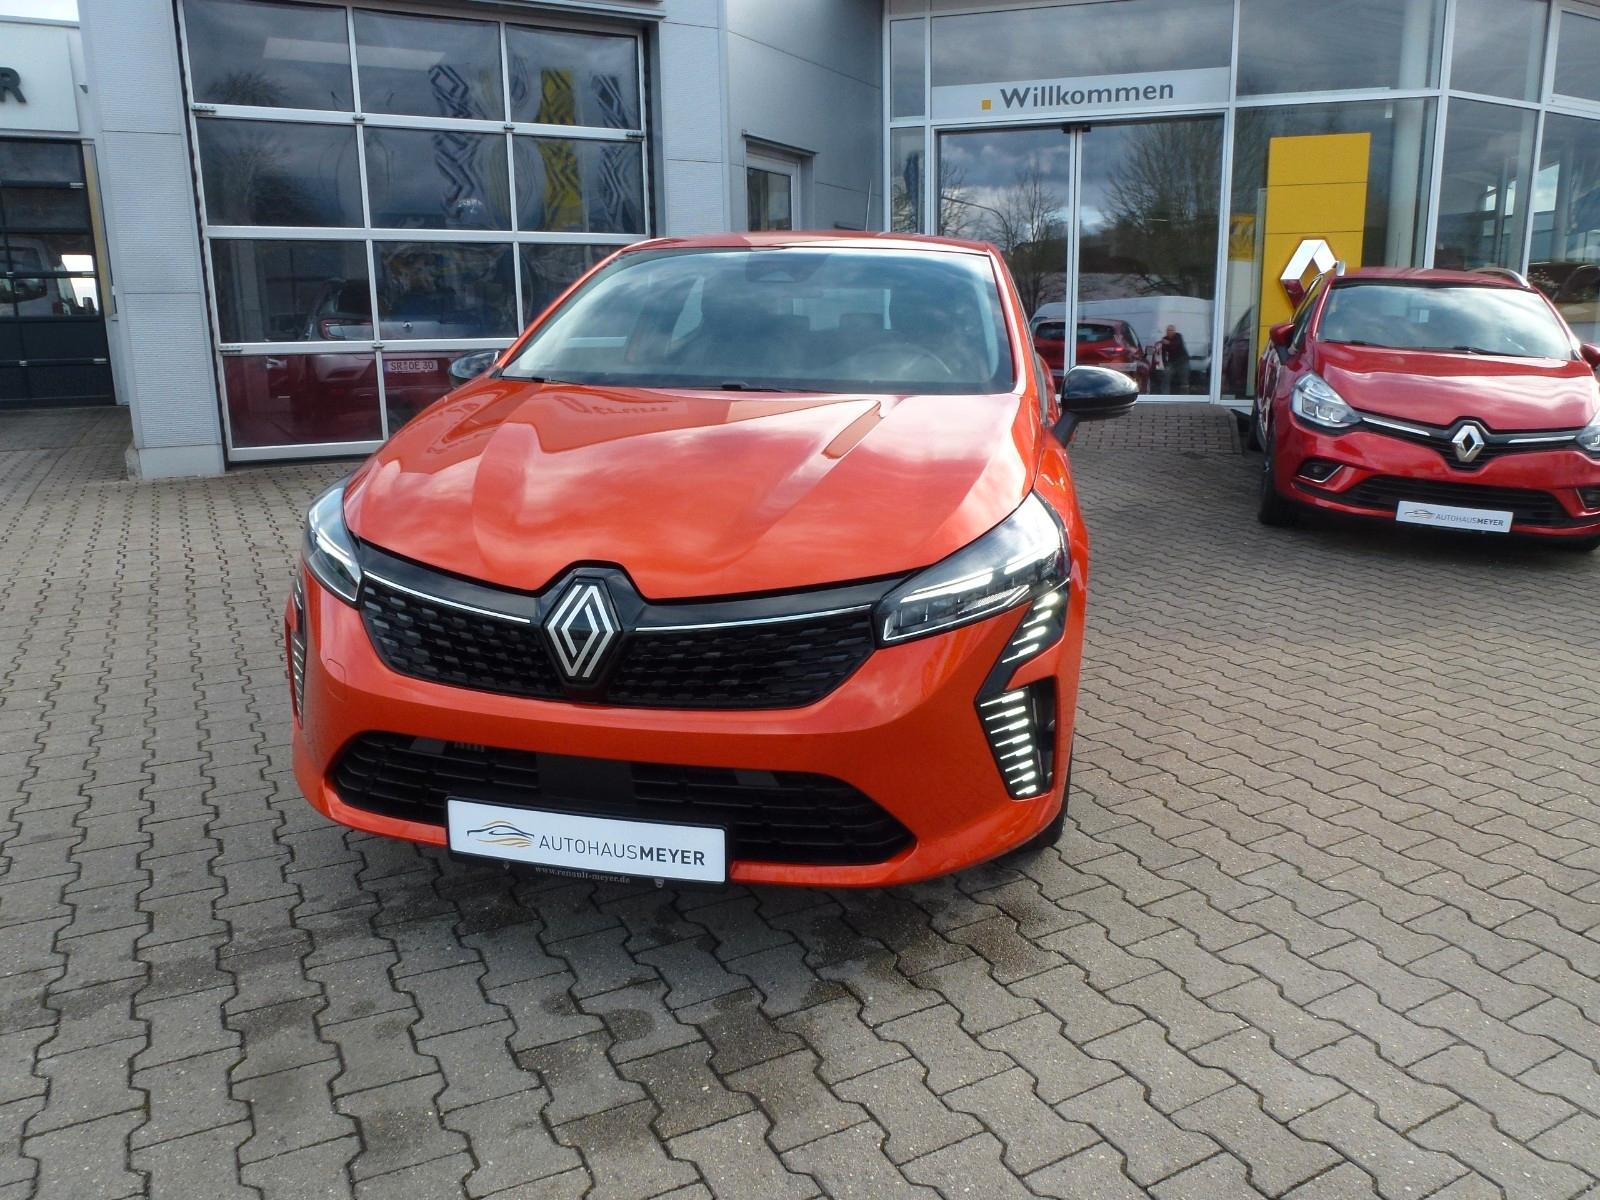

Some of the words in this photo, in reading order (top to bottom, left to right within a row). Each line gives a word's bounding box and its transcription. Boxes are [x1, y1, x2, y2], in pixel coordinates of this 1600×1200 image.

[0, 66, 27, 103] R
[1000, 84, 1174, 108] Willkommen
[539, 835, 705, 866] AUTOHAUSMEYER
[535, 866, 631, 883] www.renault-meyer.de
